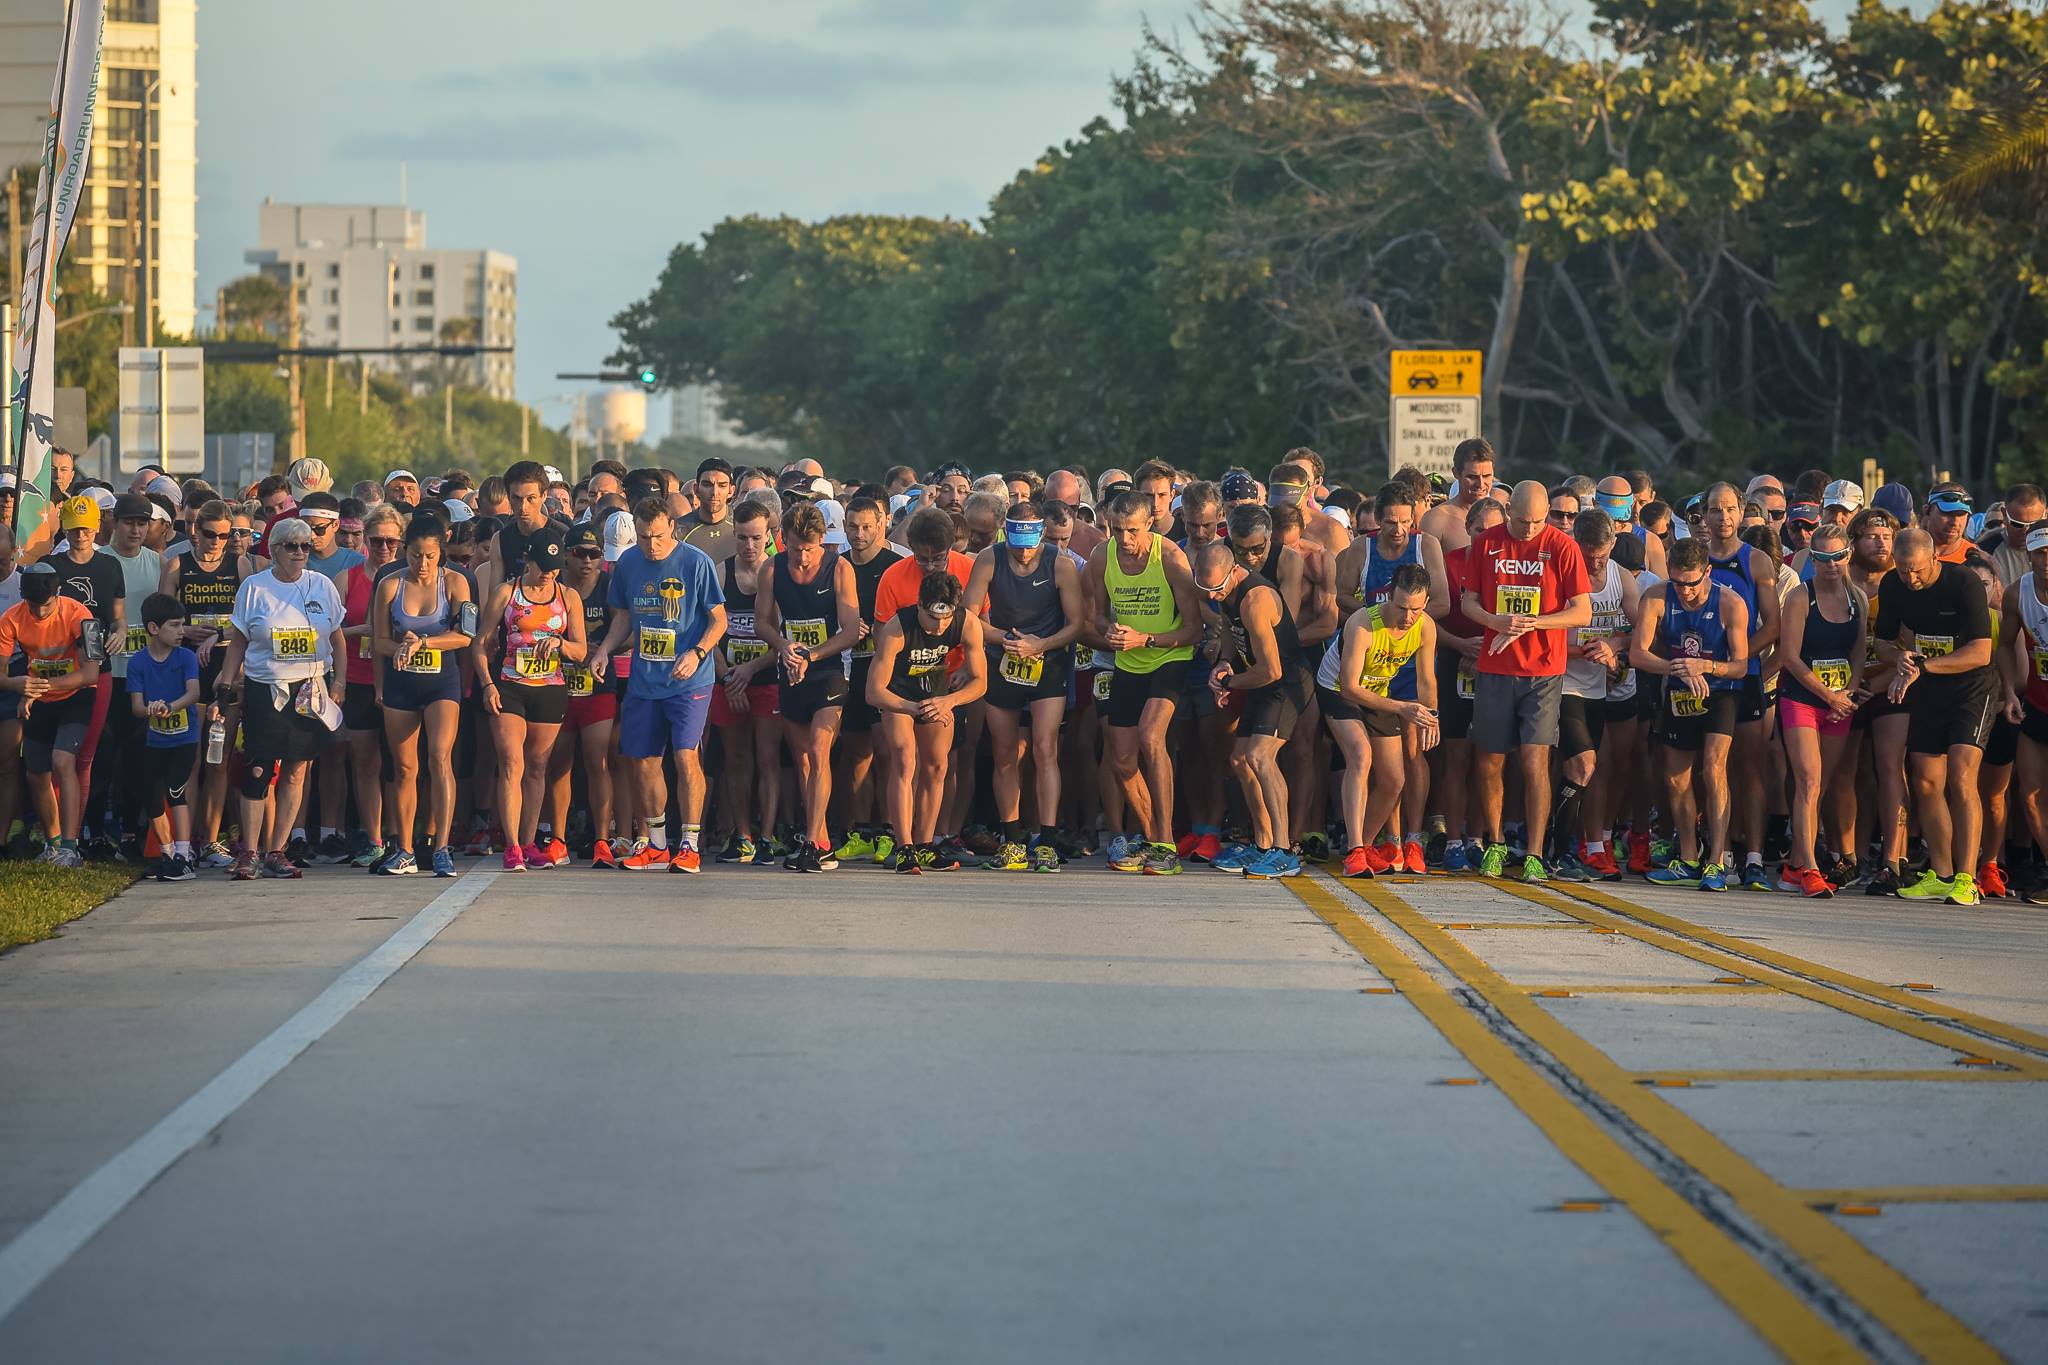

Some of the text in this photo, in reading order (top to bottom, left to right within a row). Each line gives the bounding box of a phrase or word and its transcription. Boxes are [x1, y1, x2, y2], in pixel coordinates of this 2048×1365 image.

[1399, 355, 1473, 365] FLORIDA LAW
[1402, 429, 1436, 440] SHALL
[1494, 559, 1544, 576] KENYA
[184, 583, 236, 593] Chorlton
[587, 607, 604, 618] USA
[1504, 598, 1532, 613] 160
[280, 638, 308, 654] 848
[792, 631, 820, 646] 748
[643, 639, 667, 655] 287
[524, 659, 551, 674] 730
[1006, 660, 1032, 680] 911
[1821, 671, 1846, 688] 329
